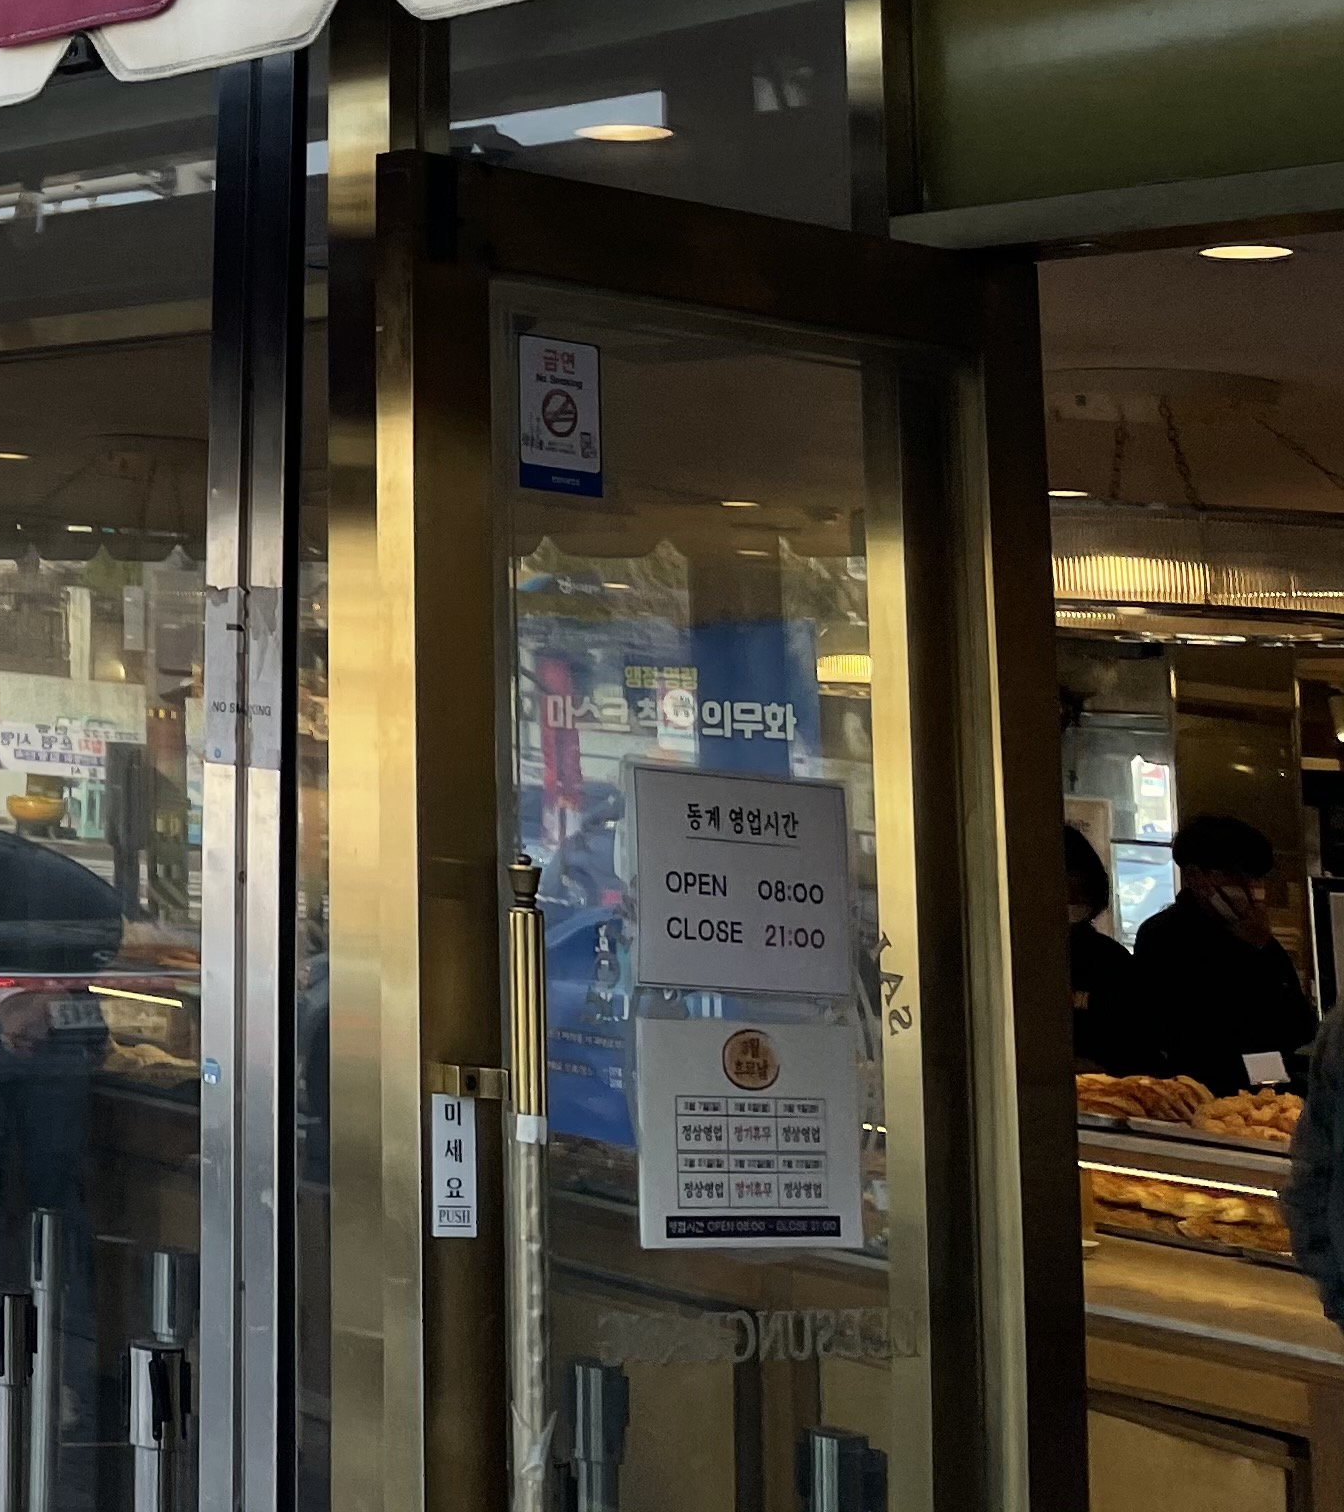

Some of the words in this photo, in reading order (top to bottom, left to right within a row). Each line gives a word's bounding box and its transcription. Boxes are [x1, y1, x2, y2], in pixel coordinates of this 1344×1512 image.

[543, 348, 576, 376] 금연
[212, 700, 227, 714] NO
[545, 695, 632, 732] 마스크
[701, 699, 797, 742] 의무화
[686, 803, 721, 832] 동계
[728, 806, 800, 839] 영업시간
[665, 870, 728, 897] OPEN
[757, 879, 824, 905] 08:00
[666, 916, 744, 944] CLOSE
[765, 924, 826, 949] 21:00
[681, 1124, 723, 1142] 정상영업
[782, 1126, 821, 1144] 정상영업
[444, 1101, 465, 1199] 미세요
[683, 1181, 725, 1199] 정상영업
[783, 1182, 823, 1200] 정상영업
[438, 1209, 472, 1224] PUSH
